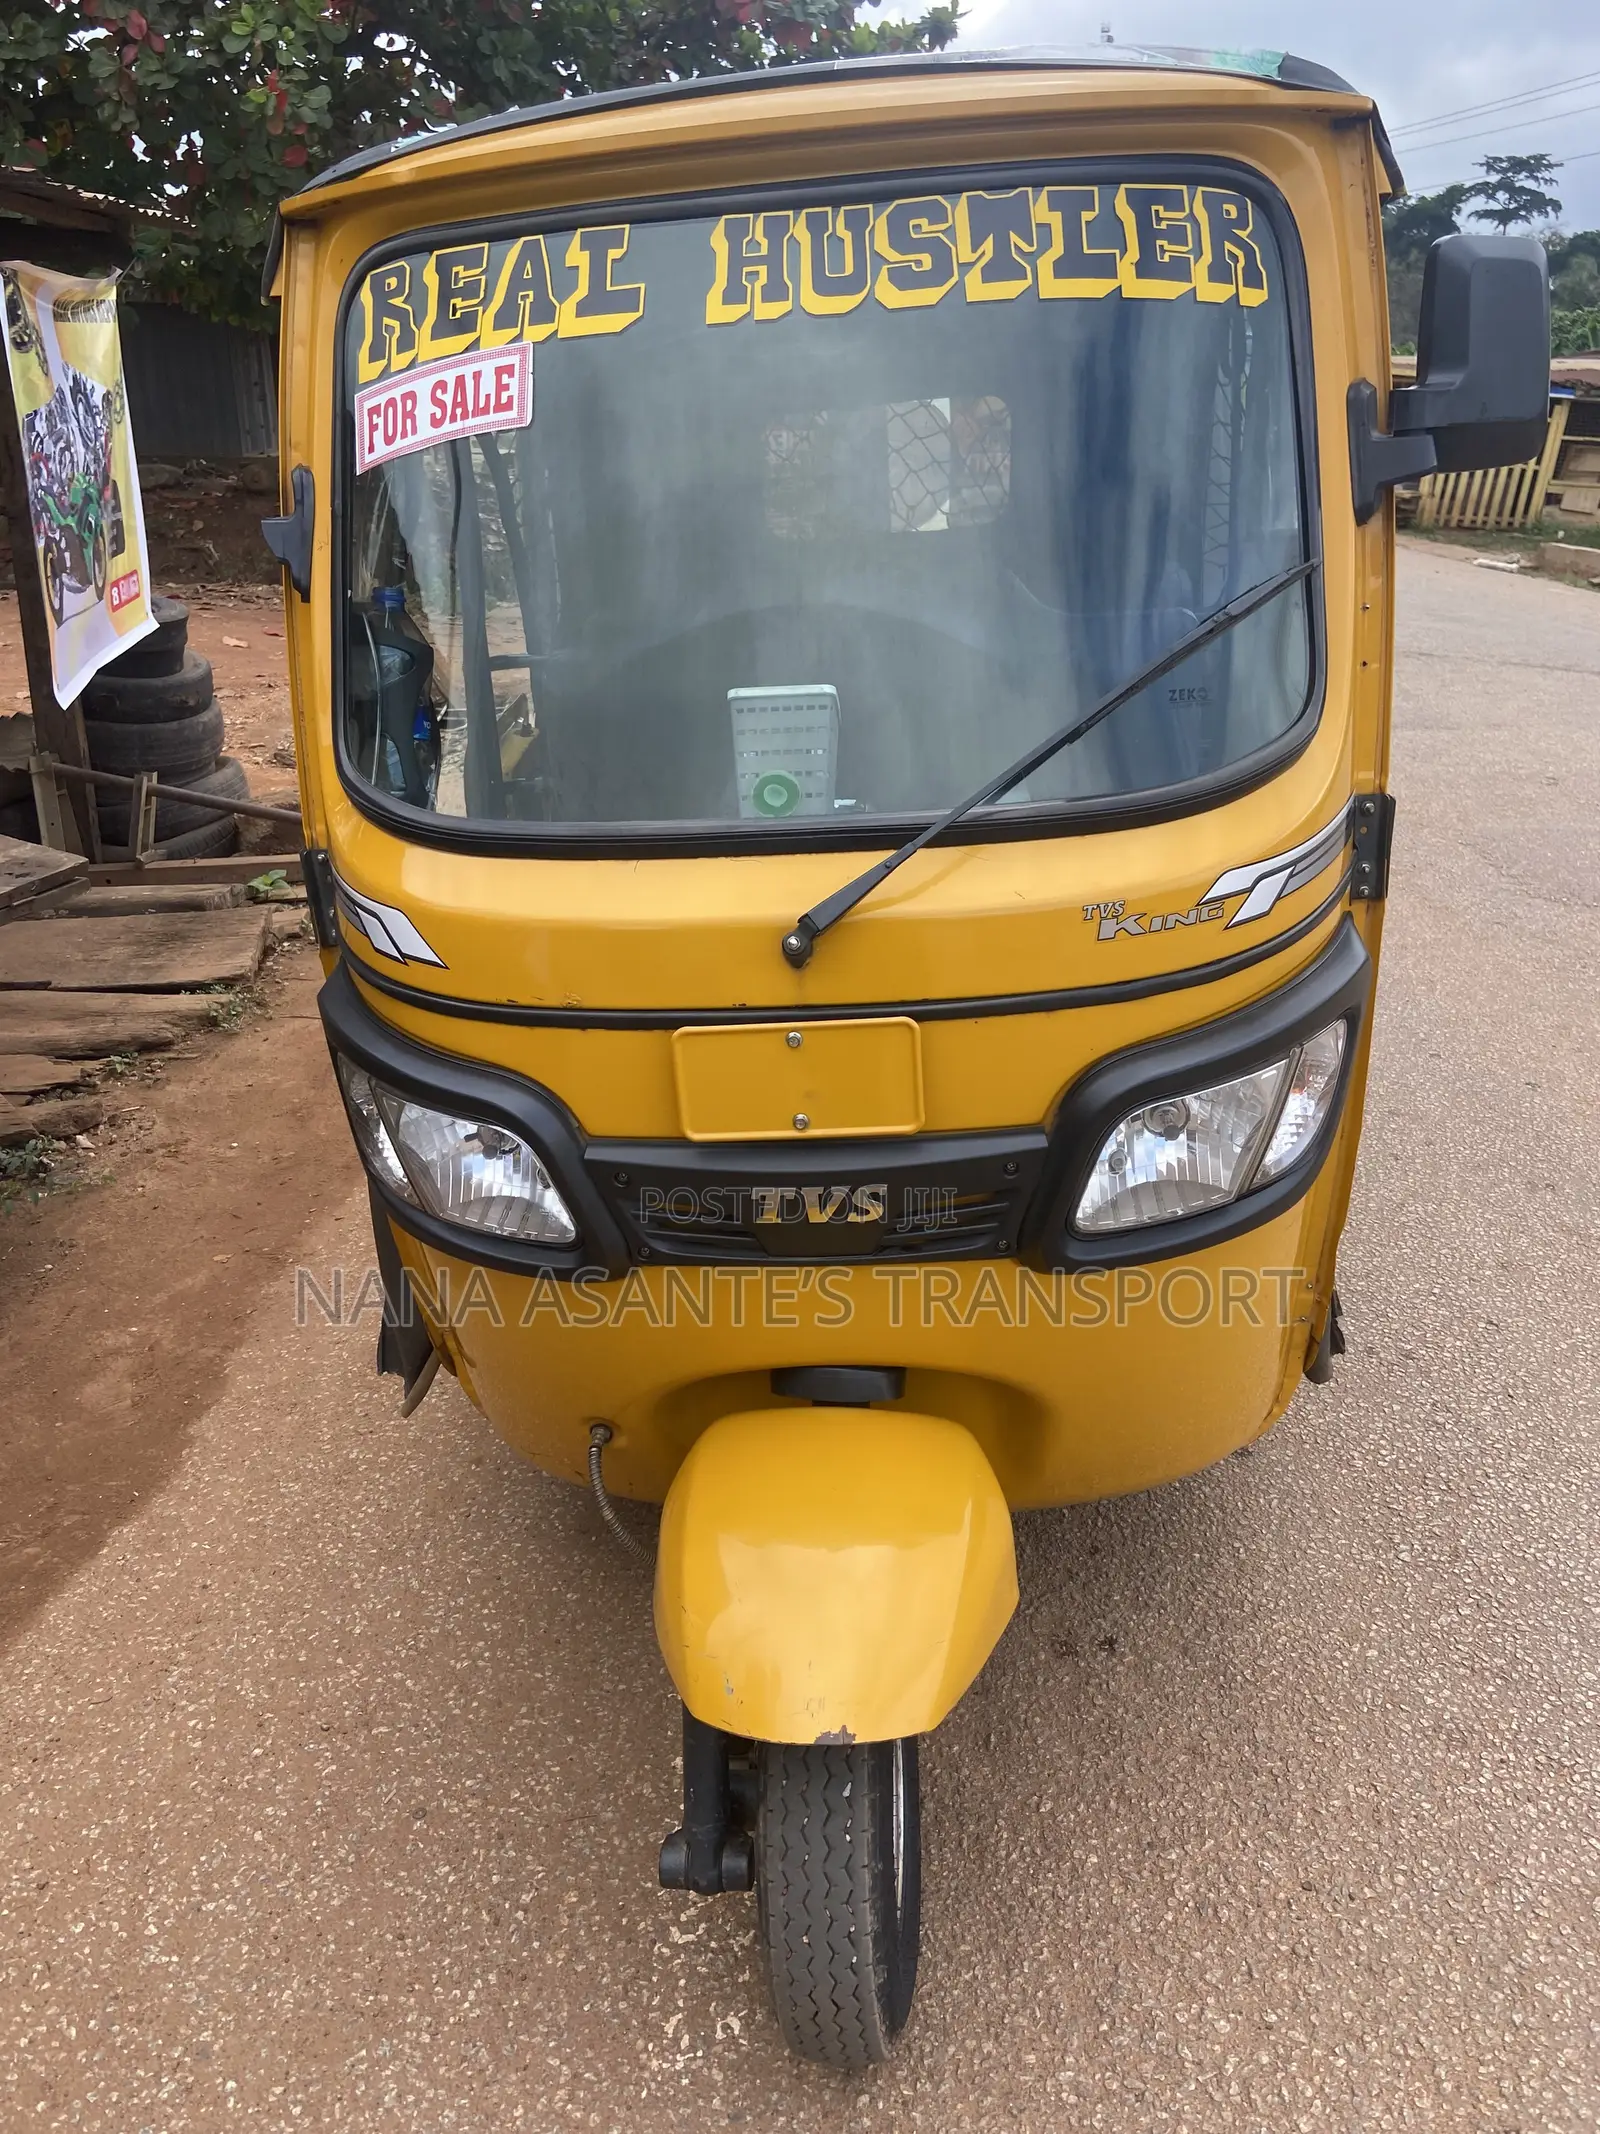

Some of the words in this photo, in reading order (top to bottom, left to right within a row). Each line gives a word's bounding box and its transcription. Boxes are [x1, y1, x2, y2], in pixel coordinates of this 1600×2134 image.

[358, 224, 645, 384] REAL
[706, 183, 1269, 325] HUSTLER
[367, 390, 418, 454] FOR
[429, 363, 516, 429] SALE
[1082, 900, 1125, 921] TVS
[751, 1184, 888, 1224] TVS
